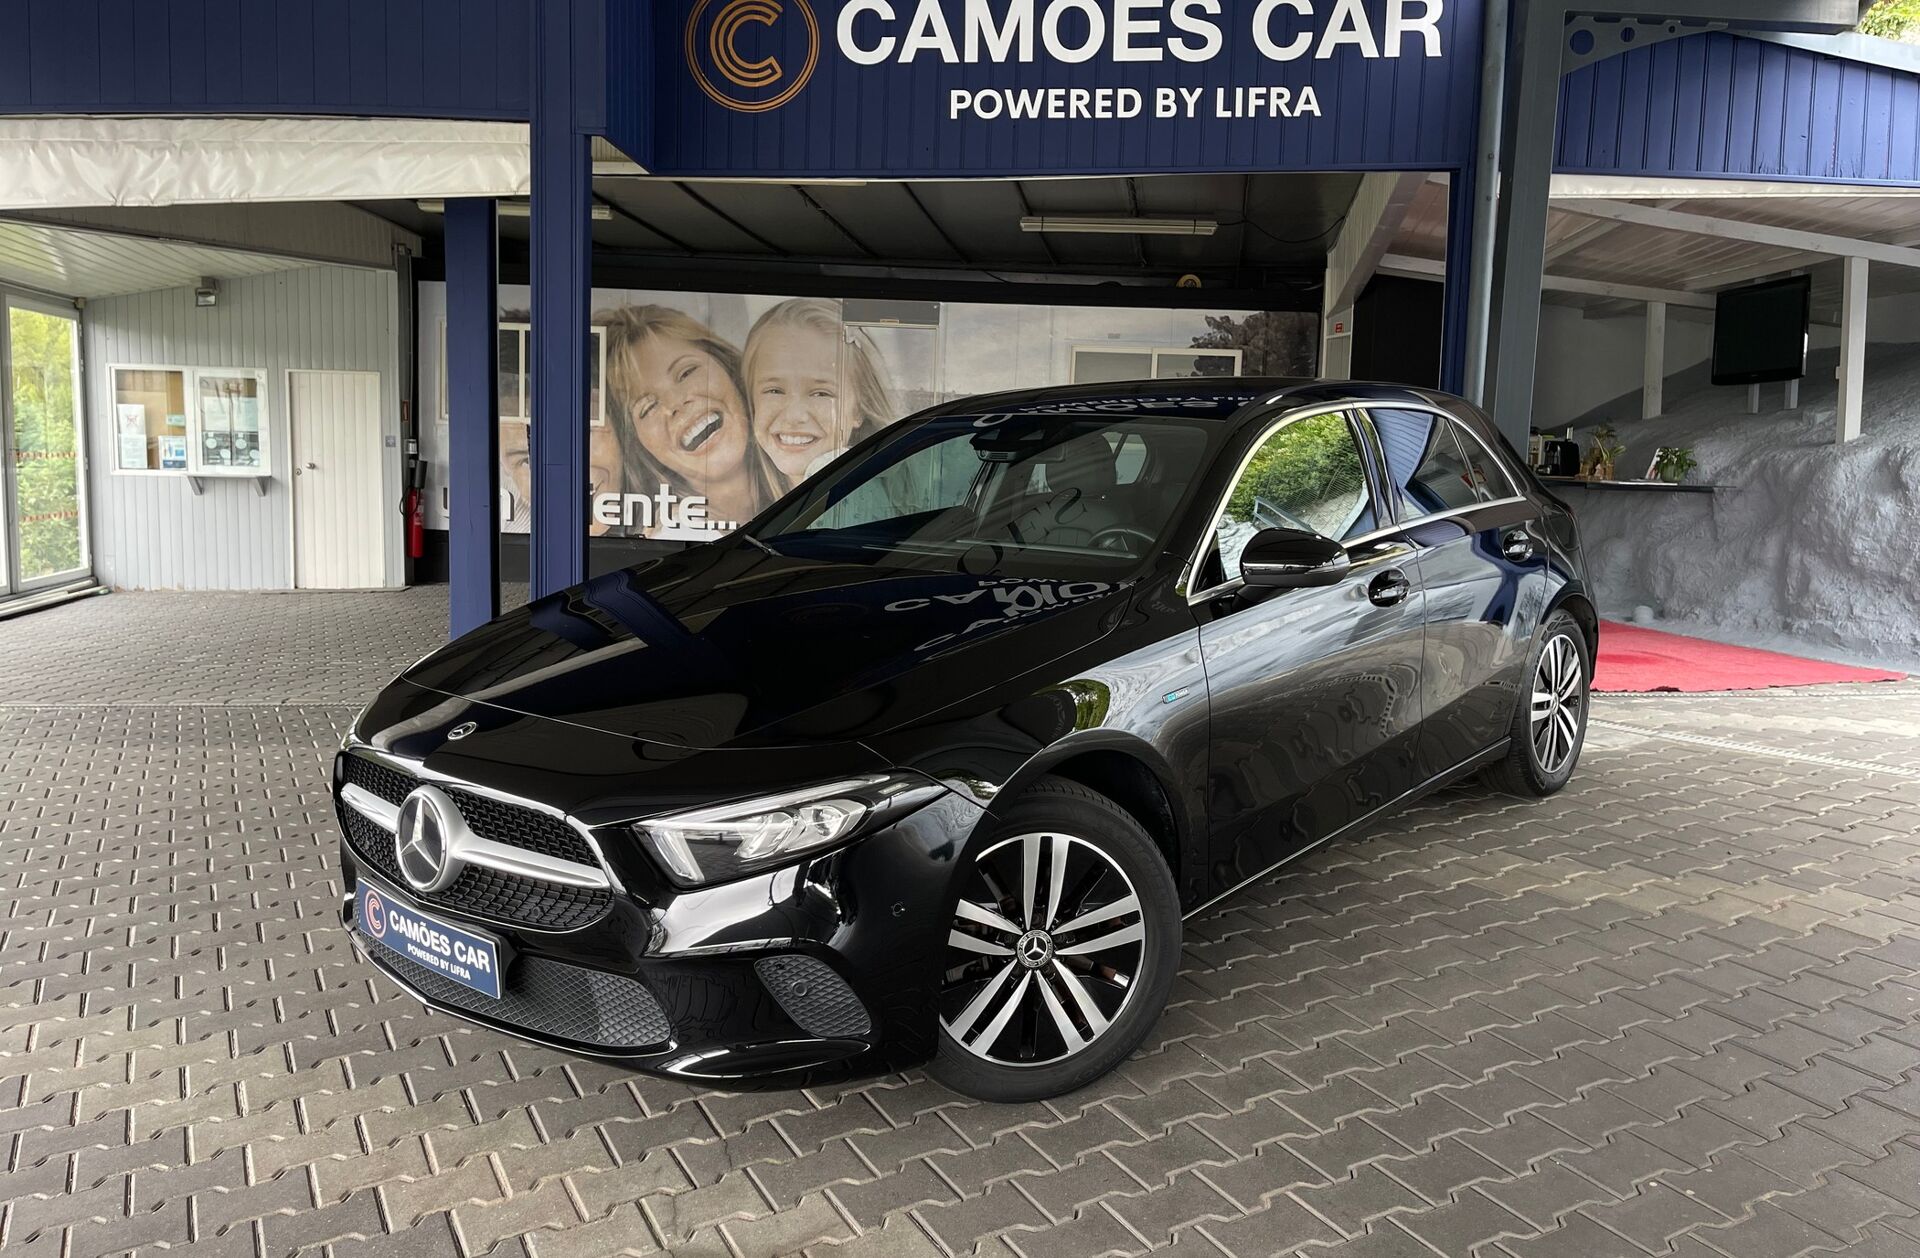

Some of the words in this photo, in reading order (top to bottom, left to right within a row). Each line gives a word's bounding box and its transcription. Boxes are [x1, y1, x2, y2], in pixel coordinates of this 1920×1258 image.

[1252, 0, 1443, 61] CAR
[950, 88, 1142, 119] POWERED
[1155, 88, 1203, 118] BY
[1215, 86, 1322, 118] LIFRA
[390, 910, 451, 956] CAMÕES
[454, 941, 491, 973] CAR
[407, 943, 440, 966] POWERED
[440, 959, 450, 971] BY
[450, 963, 471, 980] LIFRA
